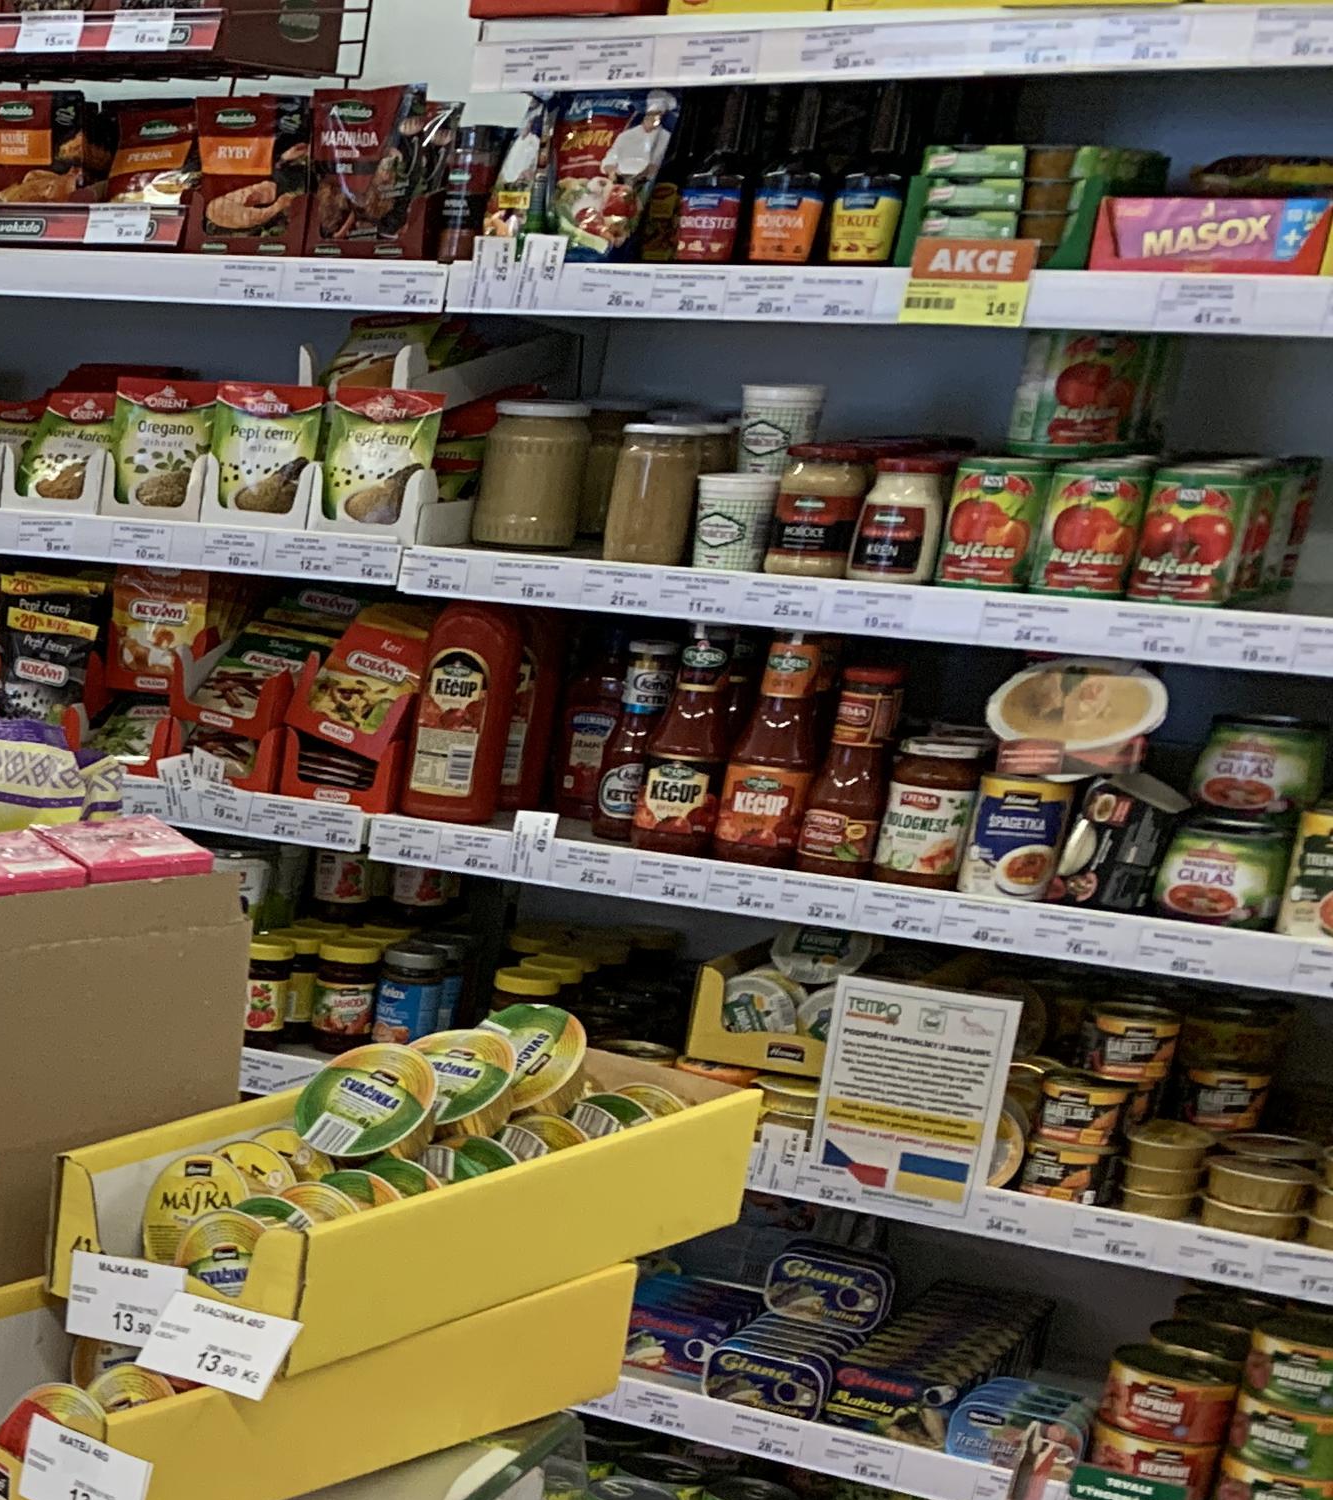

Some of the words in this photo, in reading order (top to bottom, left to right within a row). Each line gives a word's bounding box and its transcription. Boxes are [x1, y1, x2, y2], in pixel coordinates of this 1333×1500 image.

[218, 144, 253, 160] RYBY
[1143, 216, 1270, 257] MASOX
[929, 249, 1016, 273] AKCE
[149, 398, 188, 409] ORIENT
[137, 421, 193, 437] Oregano
[944, 539, 1015, 562] Rajčata
[1049, 547, 1122, 570] Rajčata
[1138, 553, 1224, 578] Rajčata
[435, 681, 477, 698] KEČUP
[1216, 758, 1274, 778] GULÁŠ
[650, 780, 702, 802] KEČUP
[733, 791, 788, 816] KEČUP
[1177, 866, 1235, 887] GULÁŠ
[339, 1076, 403, 1111] SVAČINKA
[160, 1181, 231, 1212] MÁJKA
[98, 1260, 131, 1278] MAJKA
[193, 1302, 246, 1328] SVACINKA
